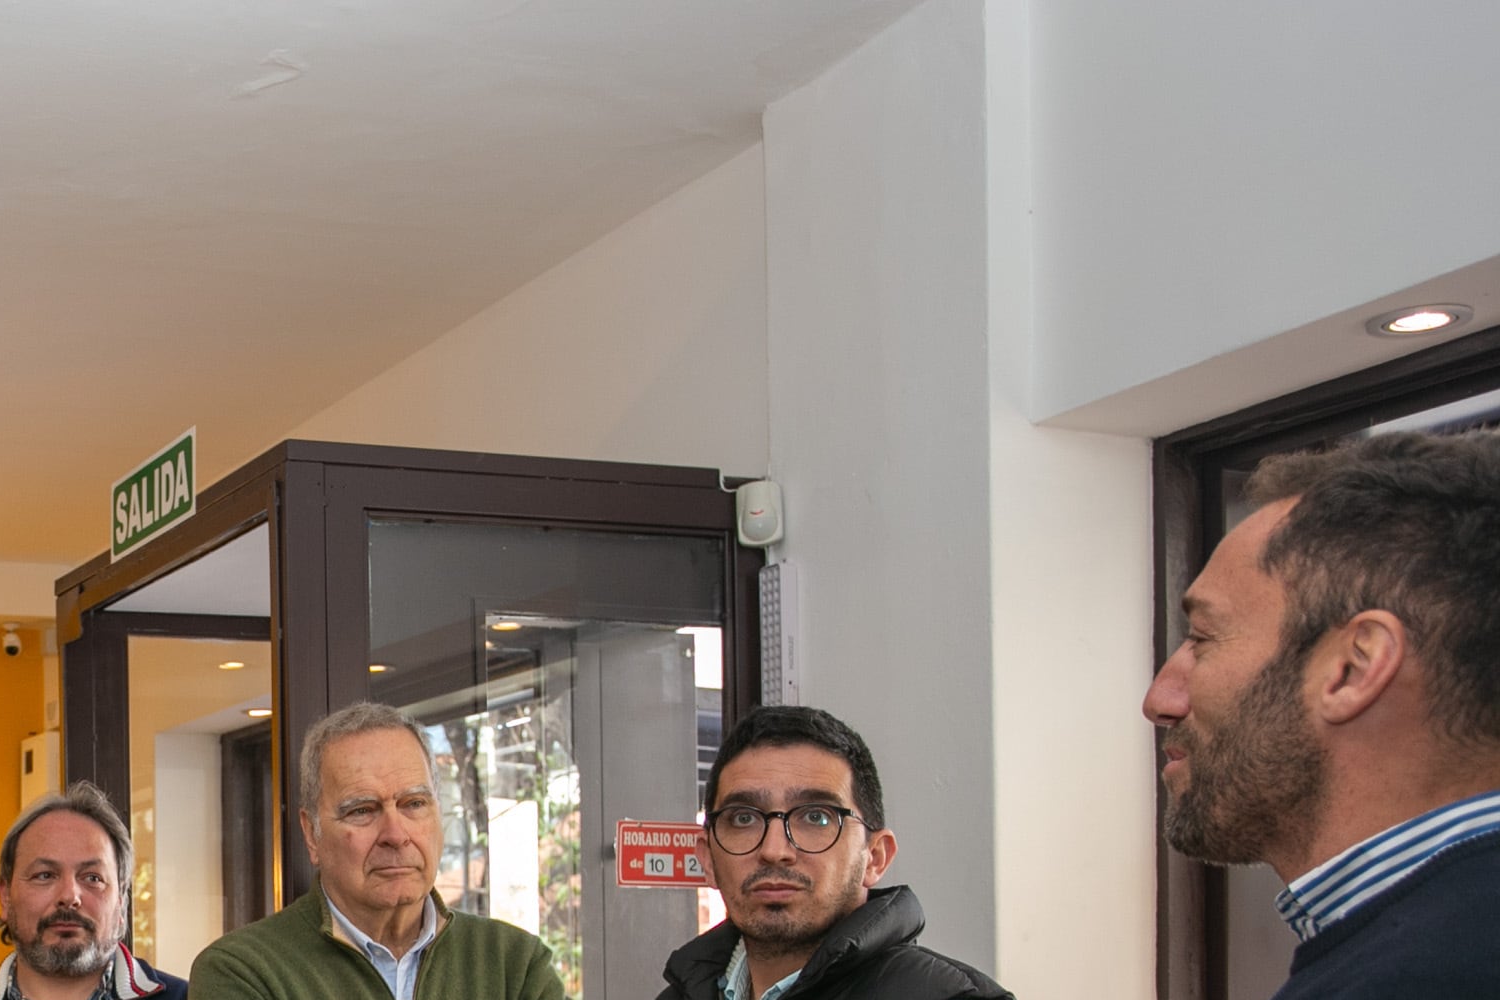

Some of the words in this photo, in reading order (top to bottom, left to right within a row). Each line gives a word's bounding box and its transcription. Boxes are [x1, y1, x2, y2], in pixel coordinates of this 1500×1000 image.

[115, 450, 190, 544] SALIDA
[623, 831, 671, 847] HORARIO
[629, 858, 643, 869] de
[649, 858, 665, 873] 10
[676, 860, 683, 869] a
